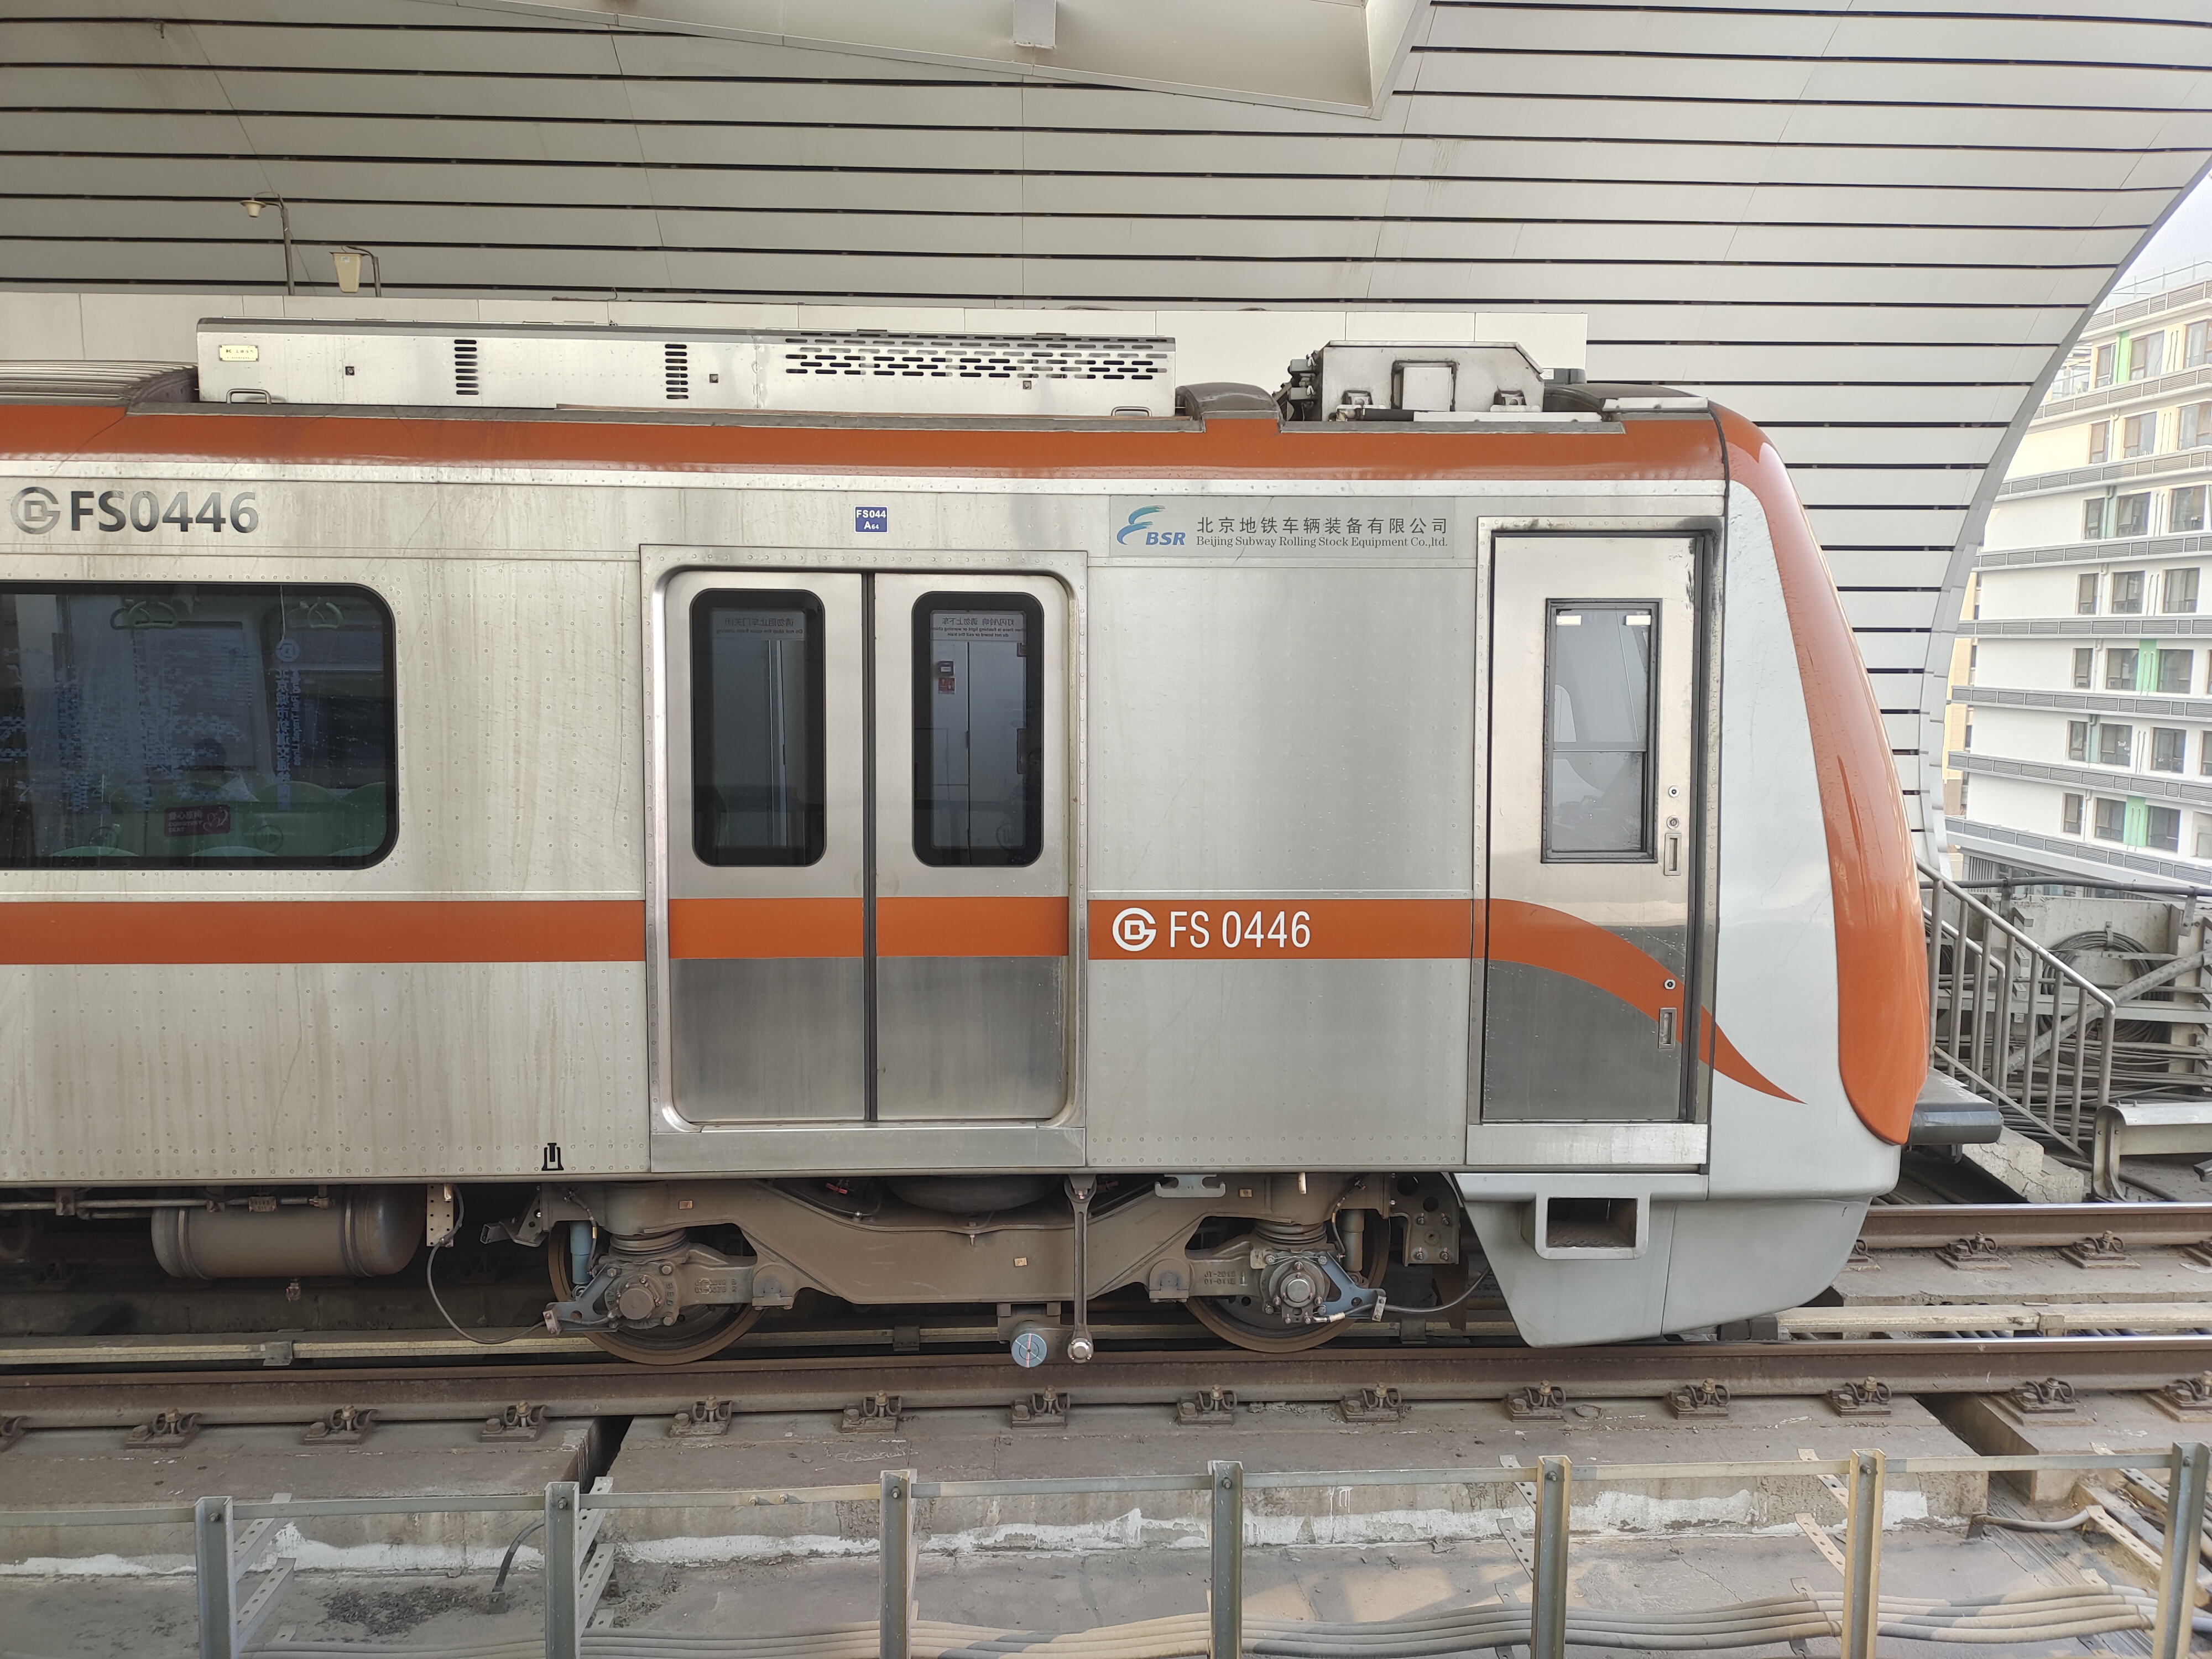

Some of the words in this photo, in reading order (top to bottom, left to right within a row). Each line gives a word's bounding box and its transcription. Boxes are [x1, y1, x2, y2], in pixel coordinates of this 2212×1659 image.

[70, 490, 259, 534] FS0446
[856, 509, 886, 518] FS044
[1197, 517, 1447, 534] 北京地铁车辆装备有限公司
[1145, 531, 1186, 546] BSR
[1196, 536, 1233, 547] Beijing
[1235, 536, 1277, 548] Subway
[1279, 536, 1317, 548] Rolling
[1318, 537, 1349, 546] Stock
[1351, 537, 1408, 548] Equipment
[1170, 910, 1210, 948] FS
[1222, 910, 1311, 948] 0446
